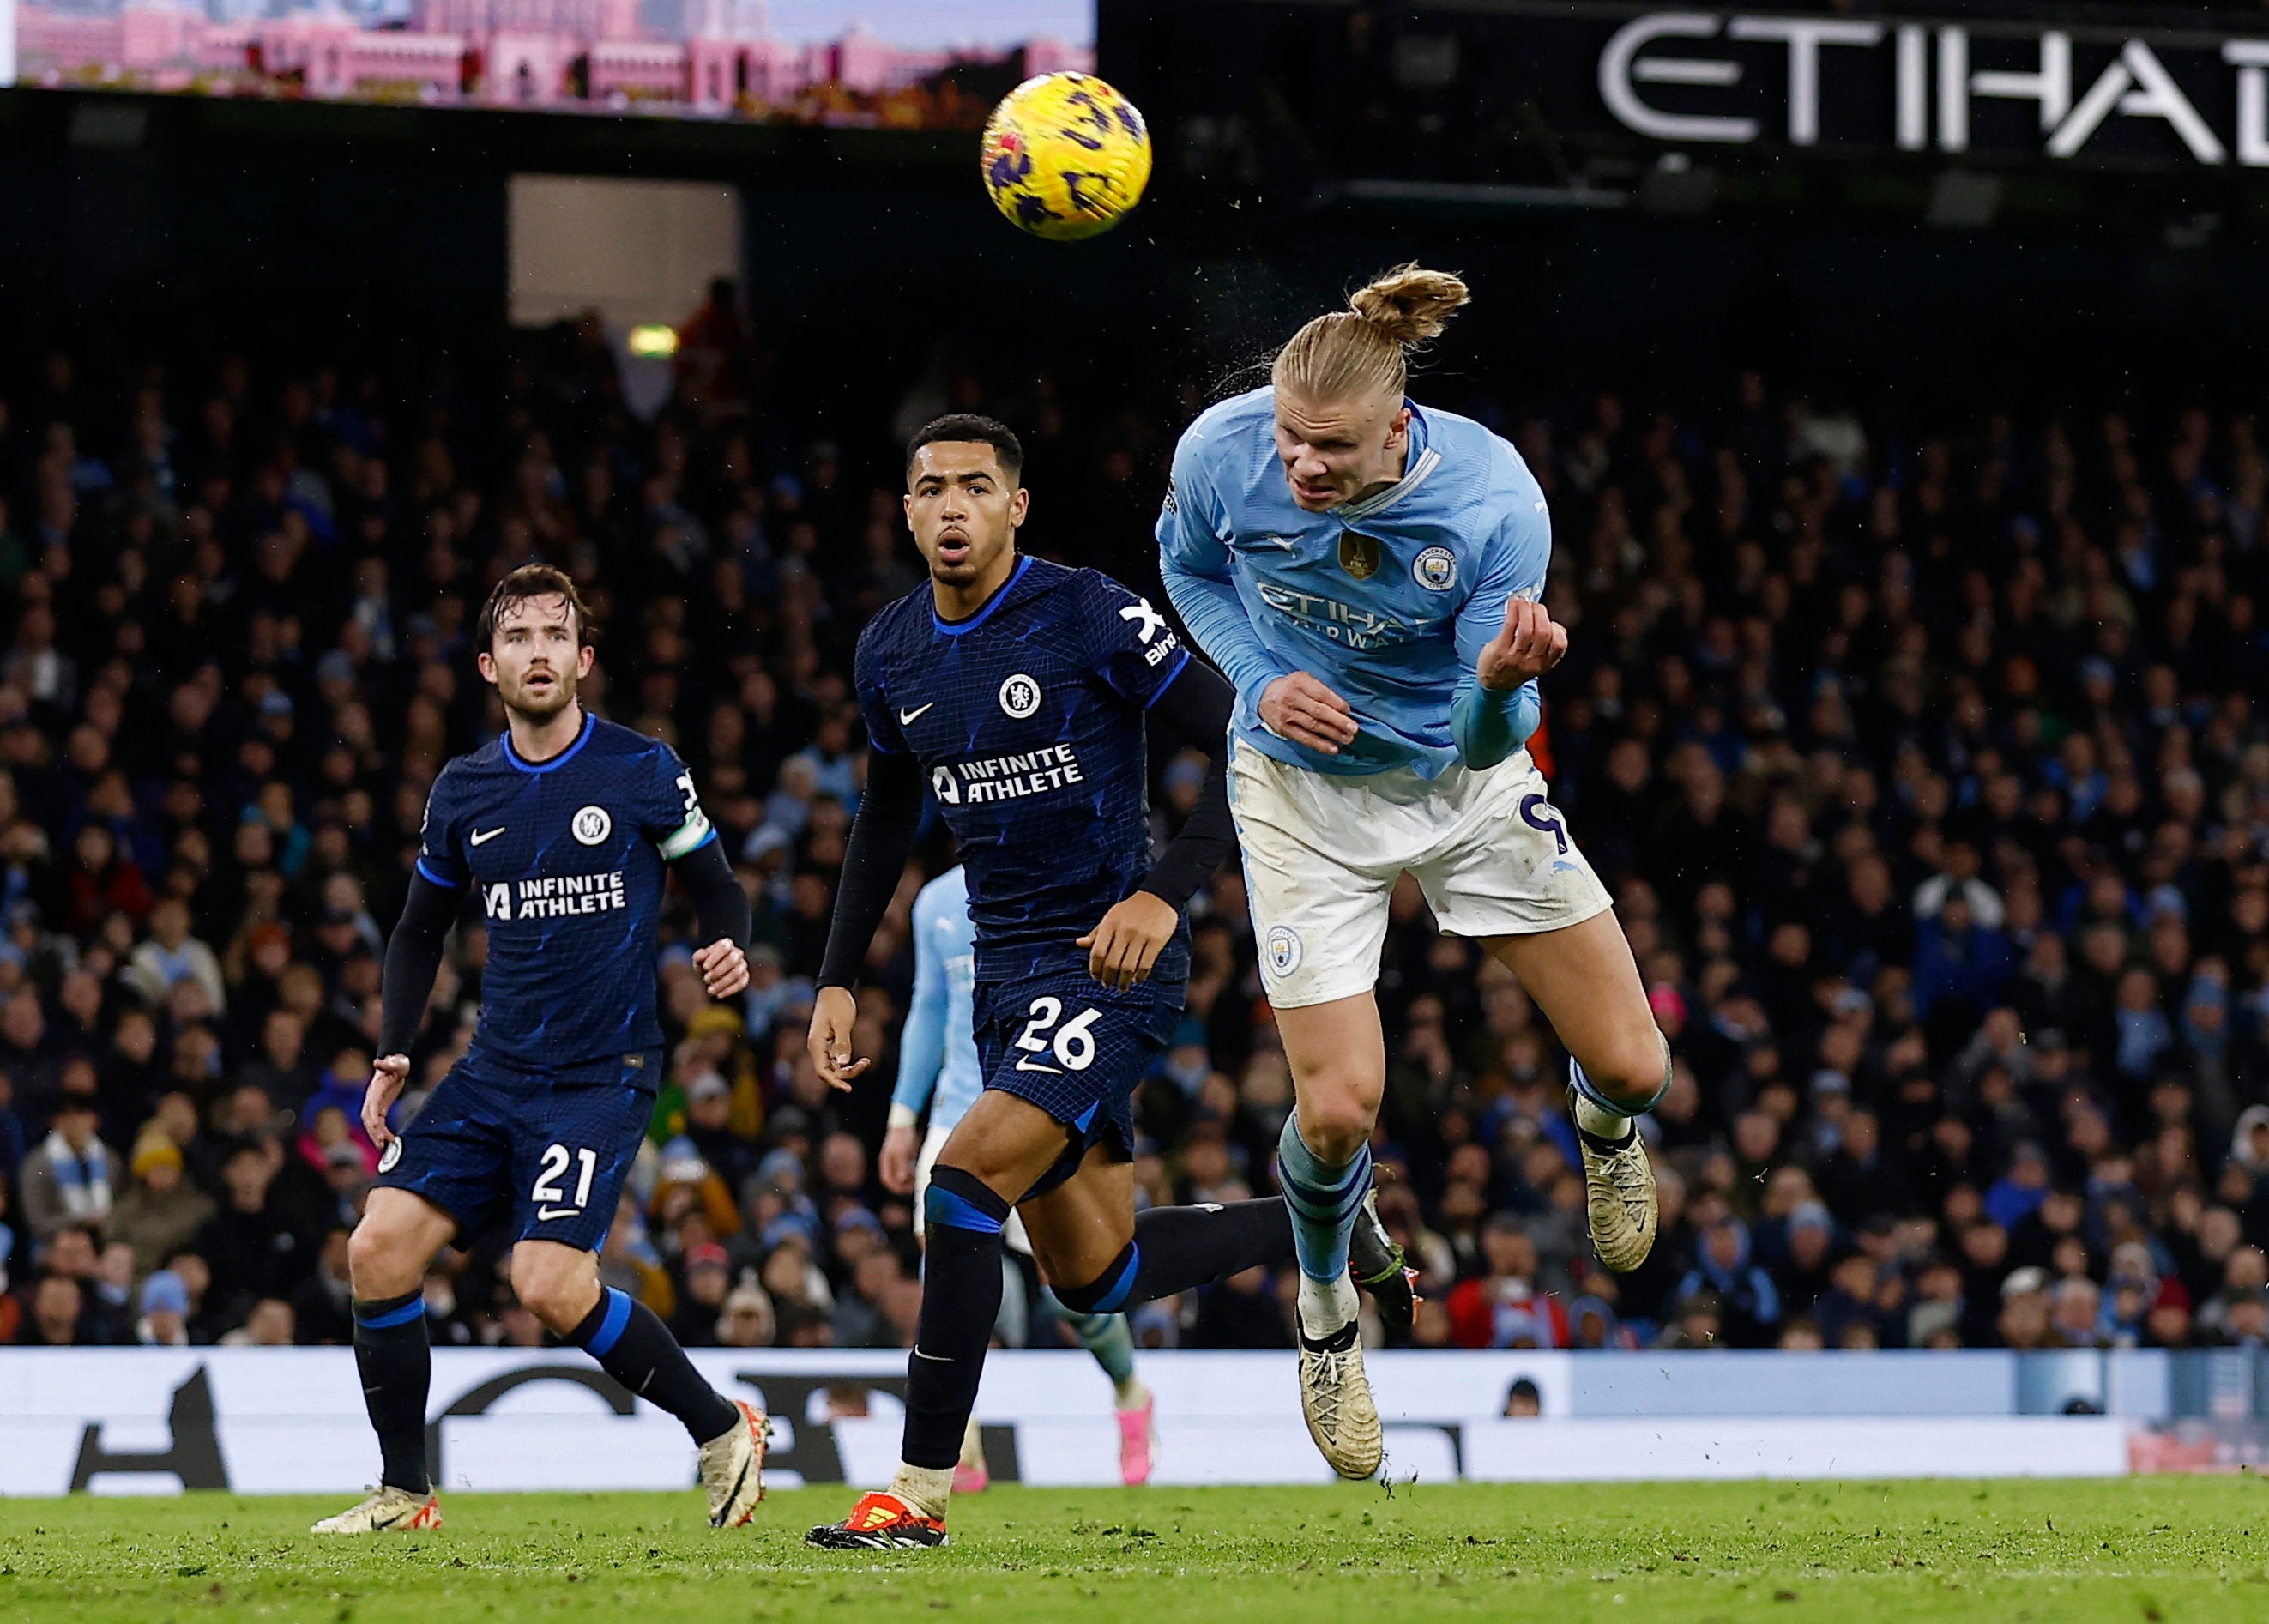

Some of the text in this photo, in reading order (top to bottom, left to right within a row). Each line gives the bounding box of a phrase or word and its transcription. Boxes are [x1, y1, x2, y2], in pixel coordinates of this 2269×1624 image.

[1257, 581, 1442, 636] ETIHA
[958, 743, 1075, 781] INFINITE
[968, 764, 1083, 803] ATHLETE
[1520, 794, 1568, 855] 9
[518, 870, 625, 899] INFINITE
[518, 889, 626, 920] ATHLETE
[1014, 996, 1104, 1071] 26
[532, 1144, 597, 1208] 21
